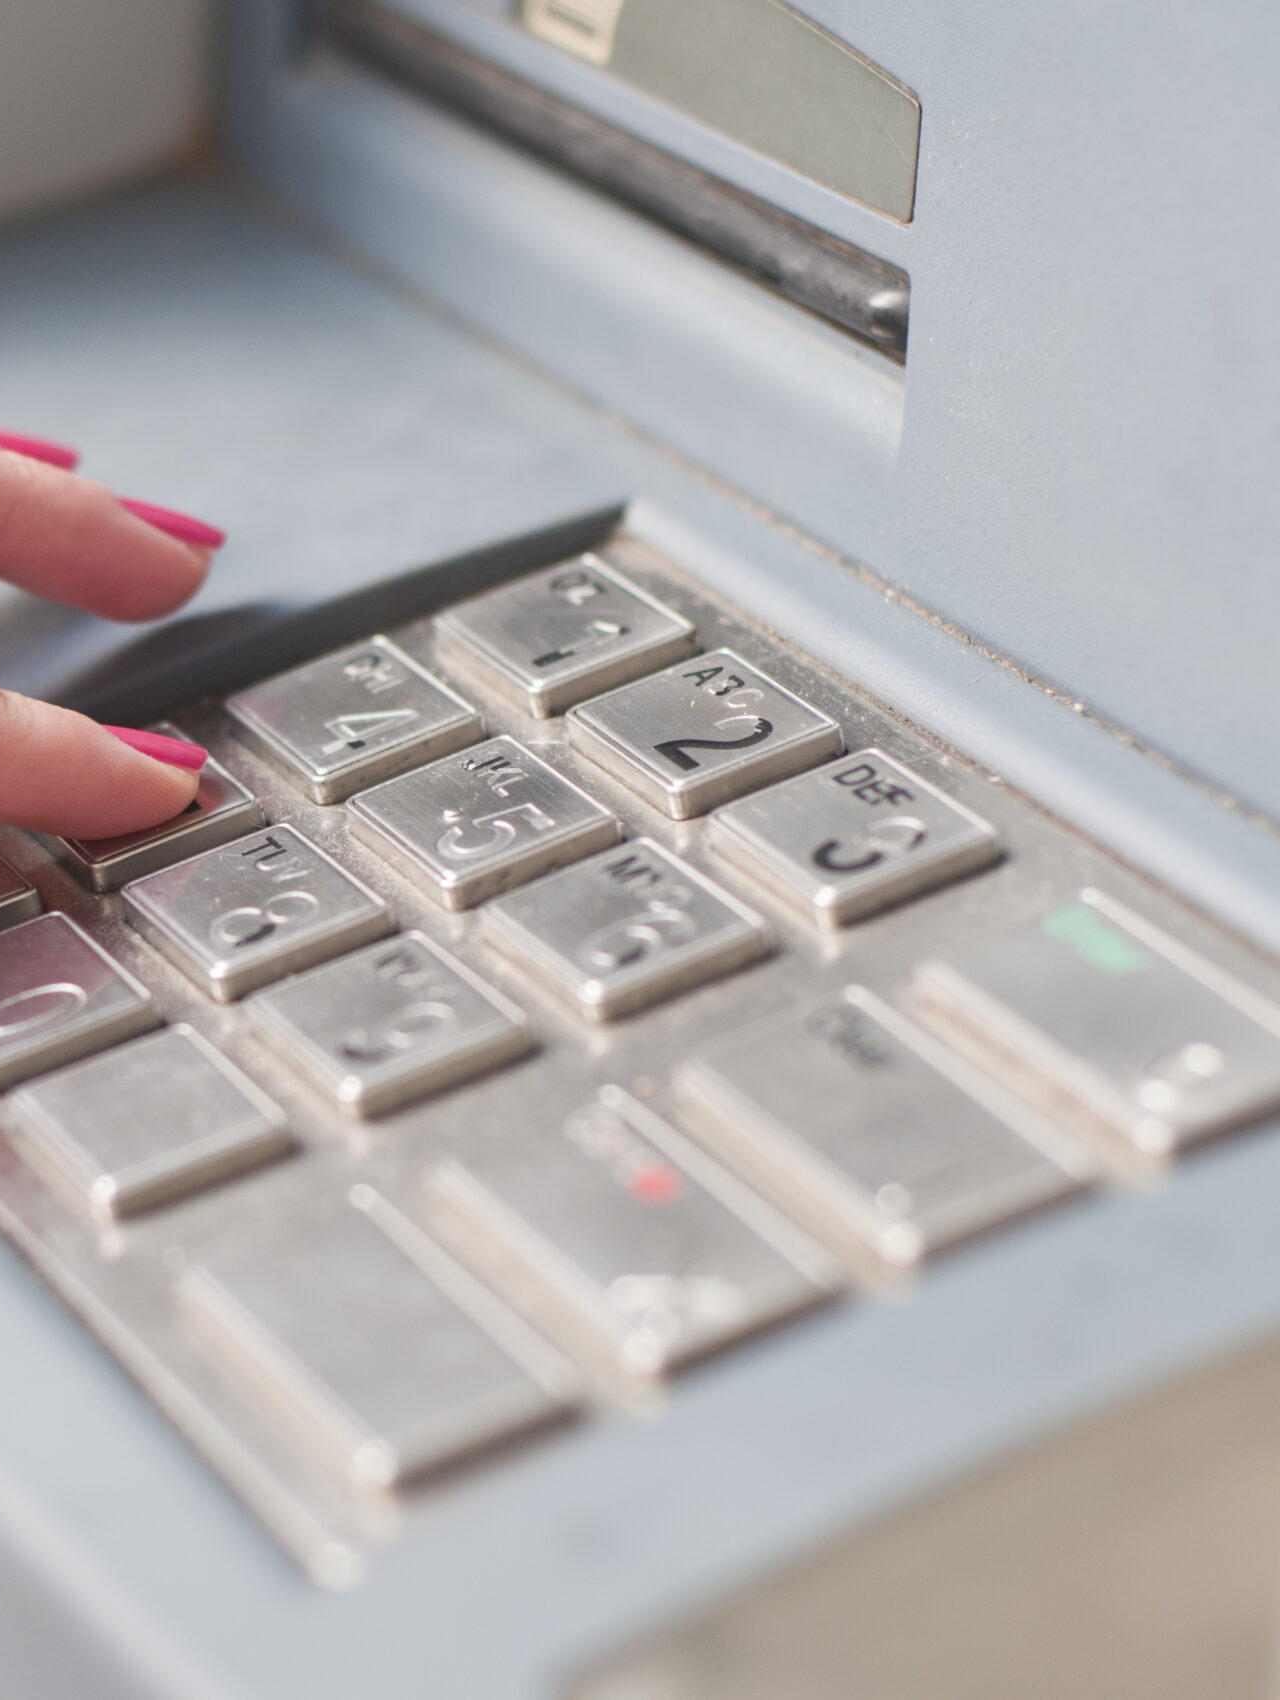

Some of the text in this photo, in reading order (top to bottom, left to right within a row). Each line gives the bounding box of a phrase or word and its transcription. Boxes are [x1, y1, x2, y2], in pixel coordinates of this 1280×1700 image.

[533, 619, 631, 668] 1
[681, 666, 764, 708] ABC
[322, 708, 419, 755] 4
[652, 714, 773, 771] 2
[460, 755, 528, 797] JKL
[832, 764, 915, 806] DEF
[437, 802, 556, 860] 5
[812, 816, 928, 872] 3
[210, 890, 319, 947] 8
[573, 908, 697, 975] 6
[337, 1001, 456, 1062] 9
